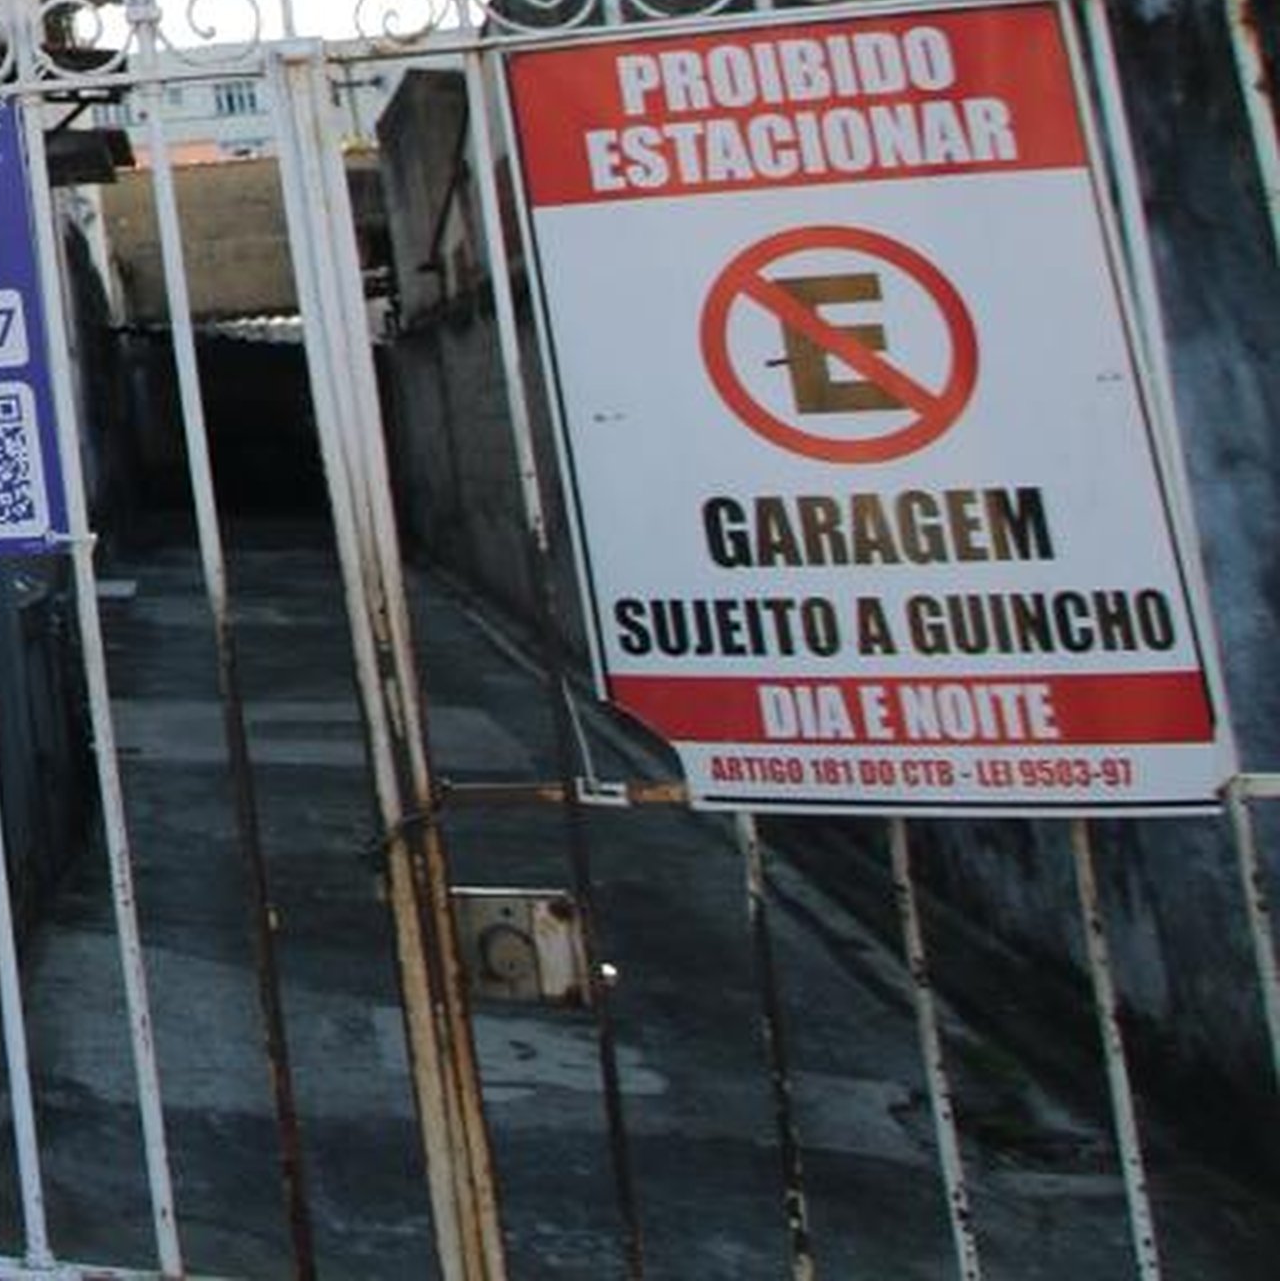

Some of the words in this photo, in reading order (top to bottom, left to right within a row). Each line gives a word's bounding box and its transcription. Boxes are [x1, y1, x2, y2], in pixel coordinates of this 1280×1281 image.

[615, 26, 956, 115] PROIBIDO
[585, 98, 1018, 192] ESTACIONAR
[701, 486, 1054, 569] GARAGEM
[613, 596, 840, 657] SUJEITO
[856, 595, 897, 656] A
[906, 588, 1176, 655] GUINCHO
[758, 684, 856, 740] DIA
[860, 684, 895, 739] E
[896, 682, 1062, 739] NOITE
[710, 755, 804, 784] ARTIGO
[810, 756, 855, 785] 181
[859, 756, 896, 785] DO
[902, 757, 955, 786] CTB
[976, 757, 1014, 786] LEI
